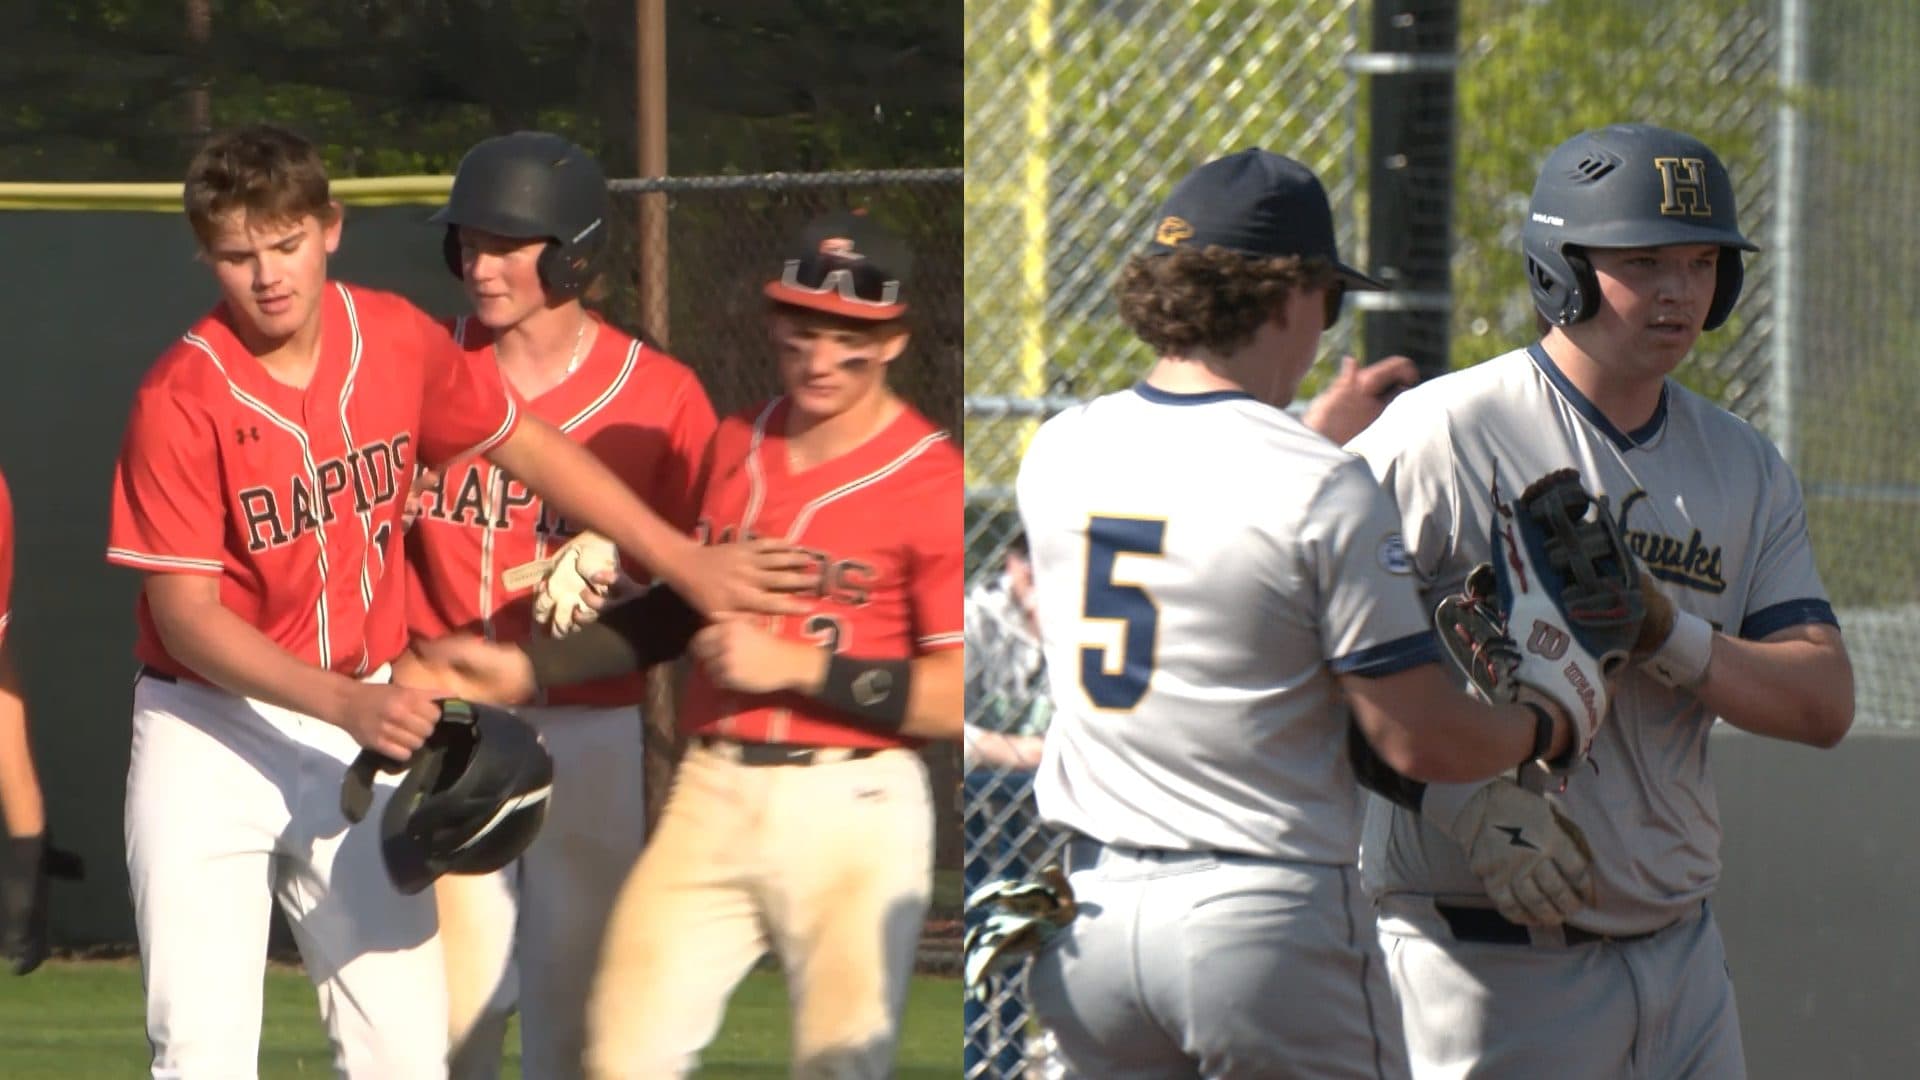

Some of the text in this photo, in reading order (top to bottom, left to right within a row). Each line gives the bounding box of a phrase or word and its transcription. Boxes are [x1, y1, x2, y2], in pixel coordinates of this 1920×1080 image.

[1654, 156, 1712, 216] H
[1618, 486, 1727, 594] awks
[1078, 512, 1169, 715] 5
[1527, 618, 1571, 662] W
